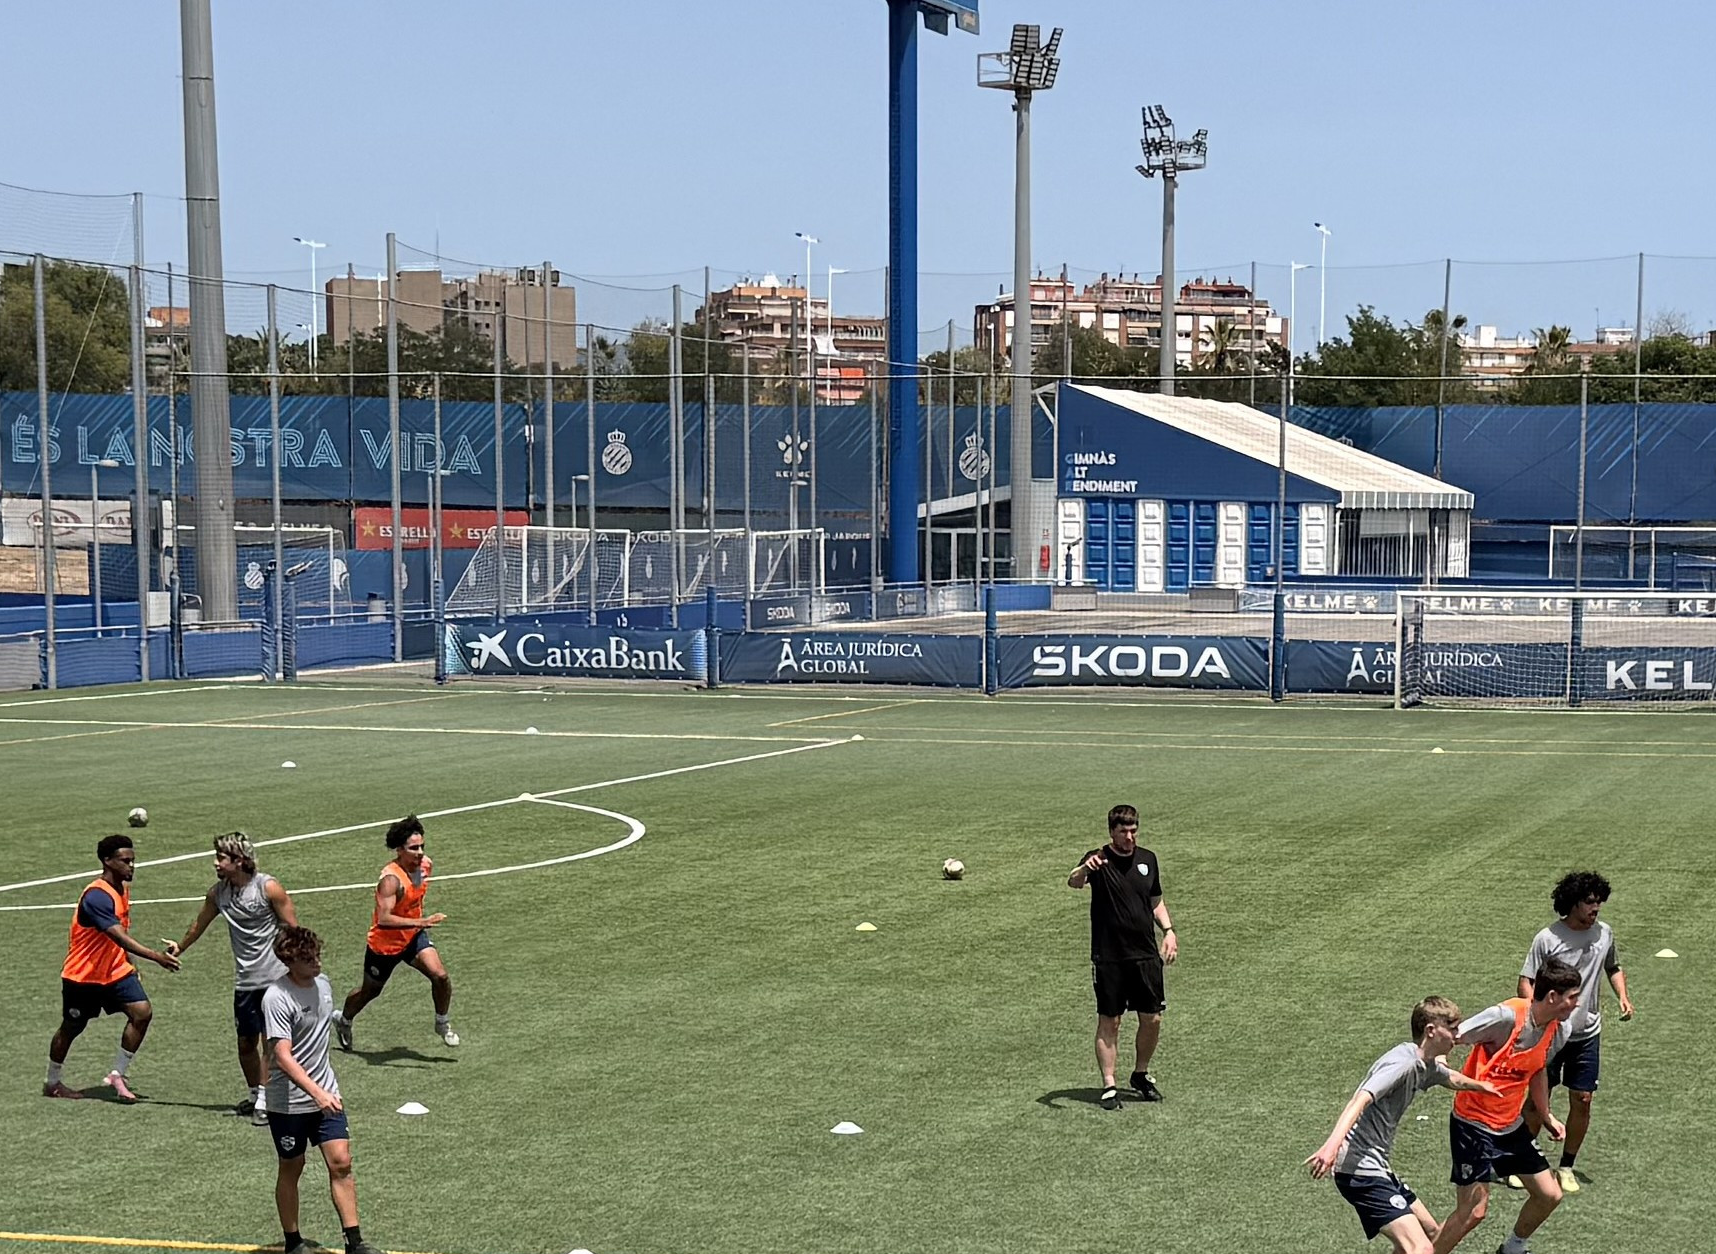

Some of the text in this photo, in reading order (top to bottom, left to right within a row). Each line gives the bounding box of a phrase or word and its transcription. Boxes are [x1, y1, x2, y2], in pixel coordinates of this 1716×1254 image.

[78, 425, 135, 467] LA
[152, 427, 342, 468] NSTRA
[360, 429, 482, 474] VIDA
[1065, 451, 1116, 465] GIMNÀS
[1065, 466, 1088, 478] ALT
[1065, 480, 1138, 492] RENDIMENT
[1539, 598, 1621, 612] KEME
[516, 634, 685, 672] CaixaBank
[845, 638, 924, 659] JURÍDICA
[800, 658, 870, 675] GLOBAL
